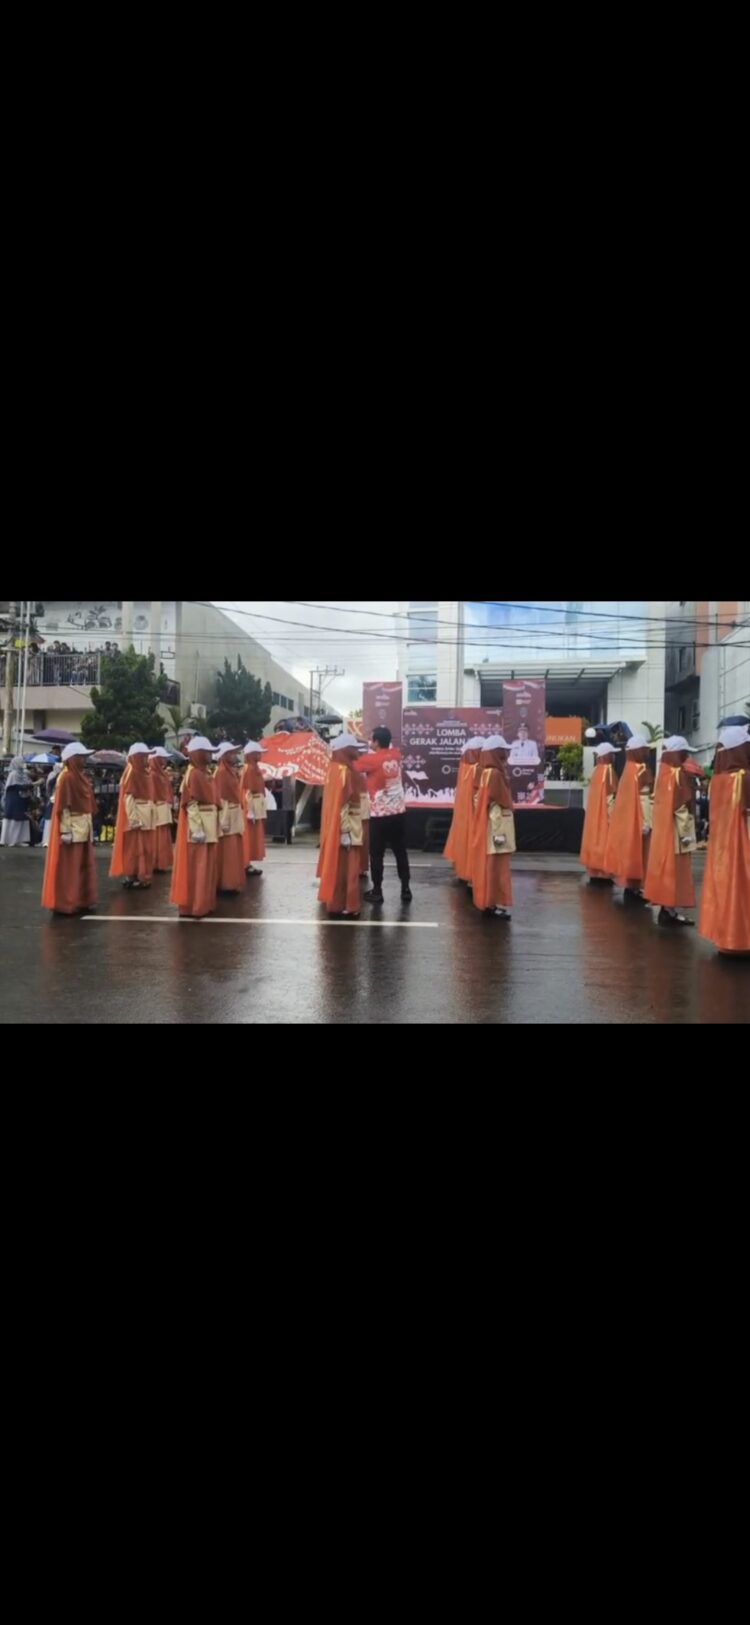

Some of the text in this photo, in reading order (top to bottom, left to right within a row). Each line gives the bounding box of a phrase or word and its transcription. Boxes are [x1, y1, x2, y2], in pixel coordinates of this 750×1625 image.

[437, 729, 466, 737] LOMBA
[409, 738, 466, 746] GERAK JALAN
